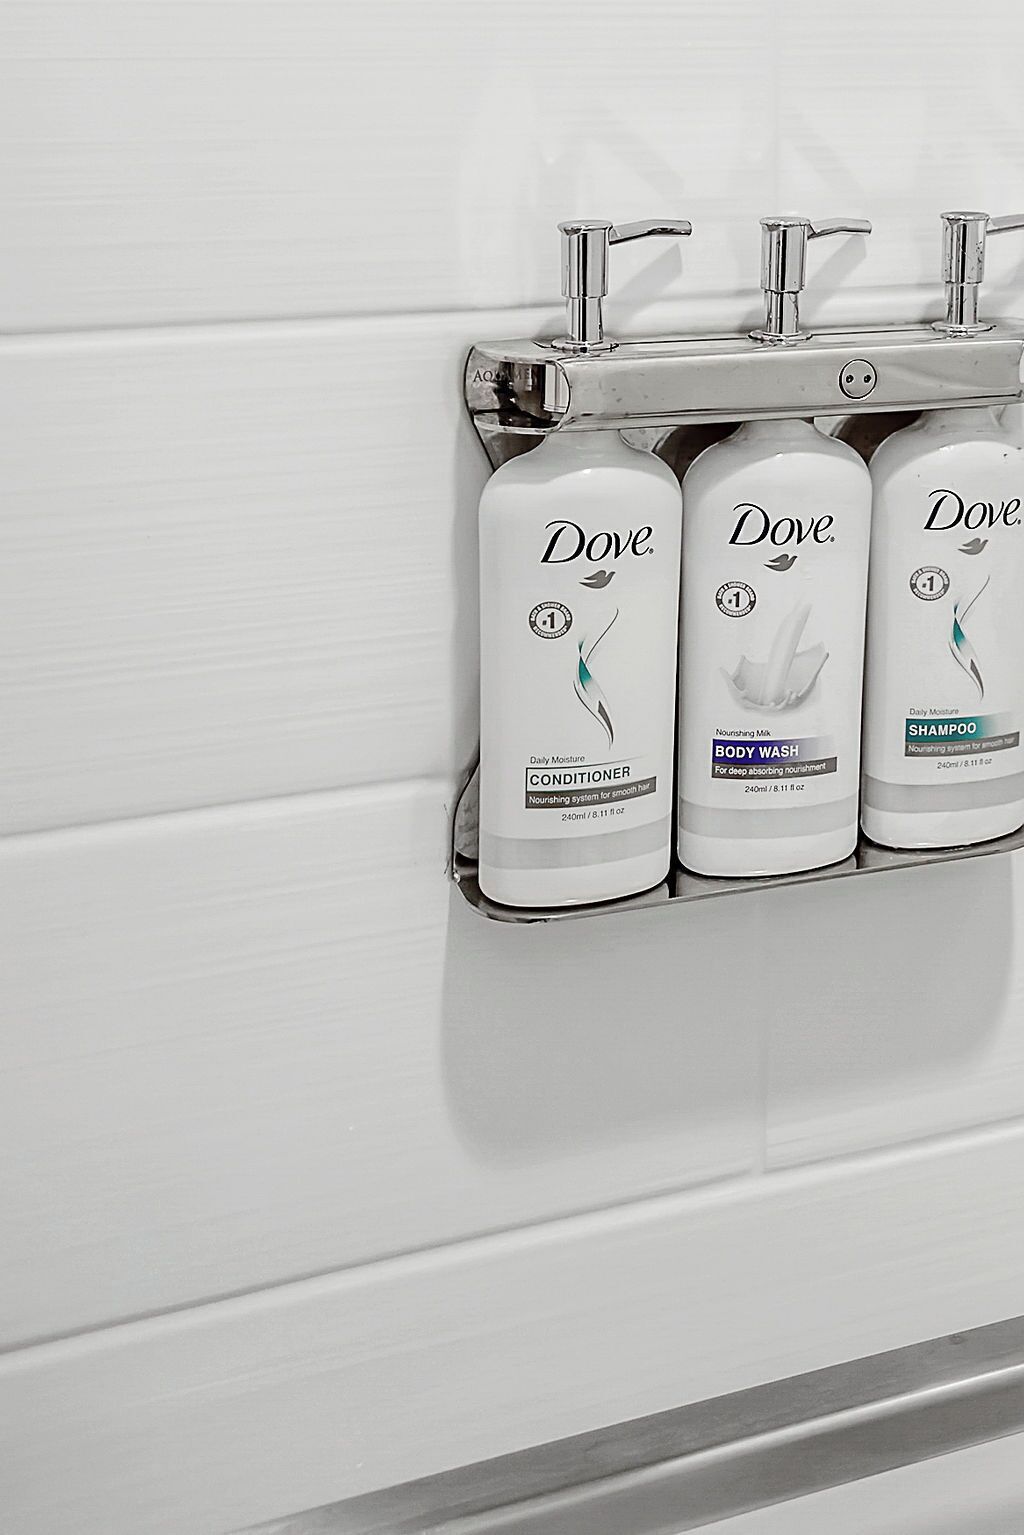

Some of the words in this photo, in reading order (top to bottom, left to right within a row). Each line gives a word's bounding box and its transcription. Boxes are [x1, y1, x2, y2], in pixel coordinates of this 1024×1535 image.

[923, 489, 1021, 531] Dove
[728, 503, 834, 546] Dove
[541, 520, 652, 563] Dove
[909, 708, 927, 717] Daily
[929, 707, 959, 716] Moisture
[716, 728, 755, 738] Nourishing
[756, 729, 771, 737] Milk
[908, 722, 977, 736] SHAMPOO
[715, 745, 755, 759] BODY
[759, 745, 799, 759] WASH
[908, 745, 945, 754] Nourishing
[947, 743, 971, 753] system
[972, 742, 981, 750] for
[530, 756, 550, 765] Daily
[551, 755, 585, 764] Moisture
[937, 760, 959, 770] 240ml
[964, 759, 977, 767] 8.11
[529, 766, 631, 786] CONDITIONER
[715, 765, 727, 774] For
[728, 767, 747, 776] deep
[748, 766, 783, 776] absorbing
[784, 762, 826, 774] nourishment
[528, 795, 570, 805] Nourishing
[571, 793, 599, 804] system
[600, 791, 611, 800] for
[612, 785, 637, 798] smooth
[638, 783, 650, 793] hair
[744, 785, 768, 793] 240ml
[561, 812, 586, 822] 240ml
[592, 810, 608, 819] 8.11
[616, 807, 625, 815] oz
